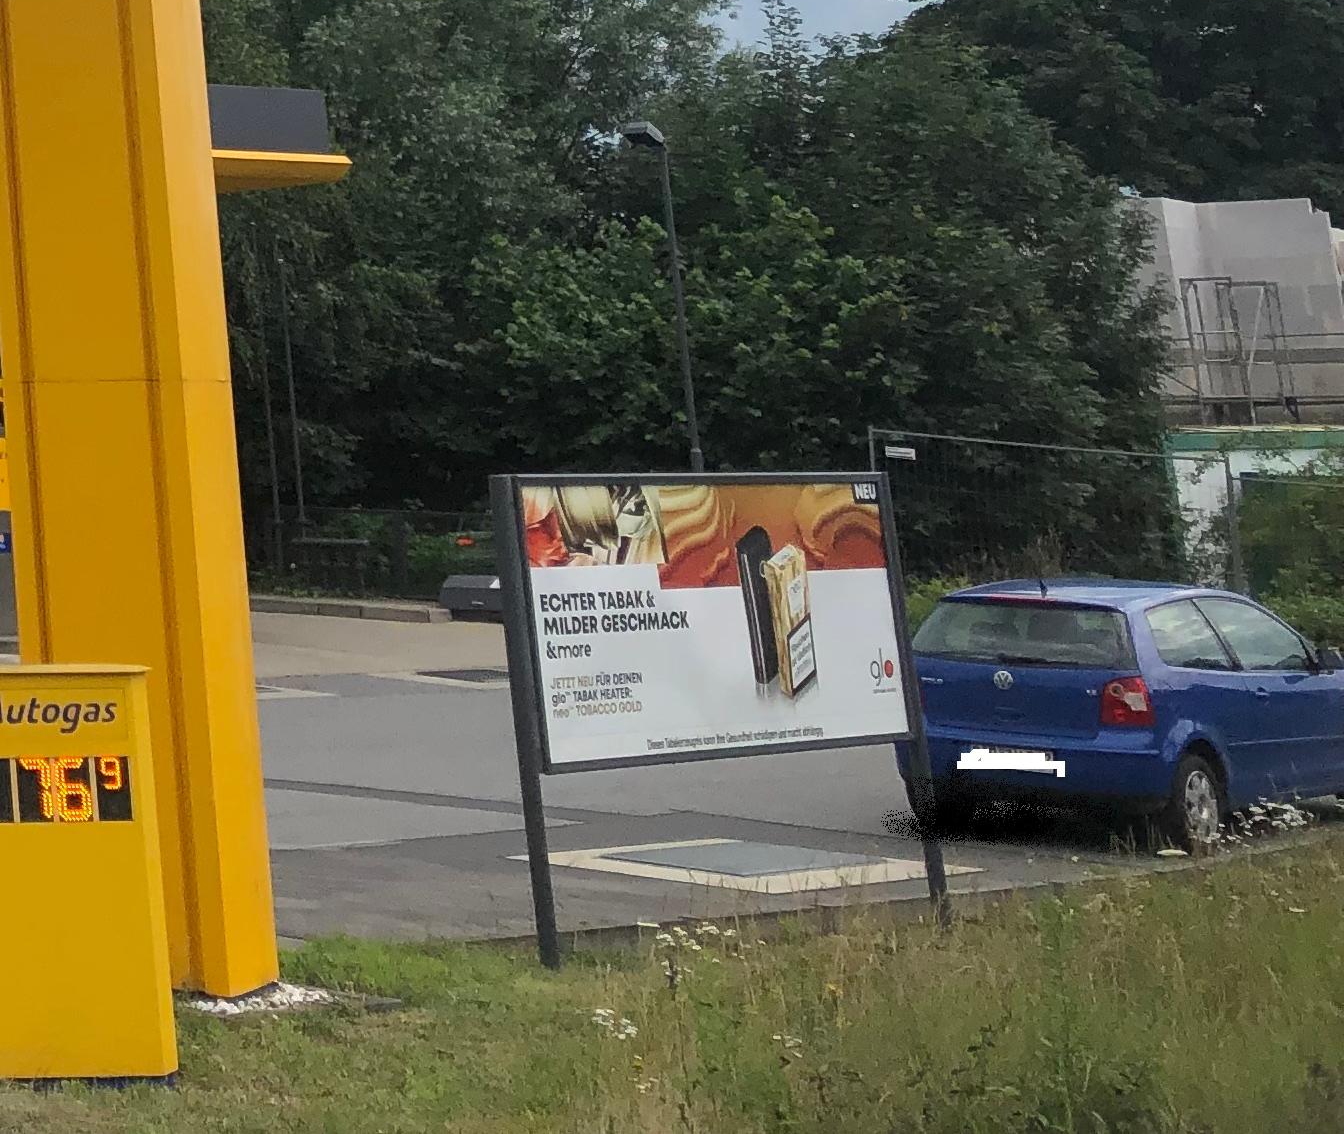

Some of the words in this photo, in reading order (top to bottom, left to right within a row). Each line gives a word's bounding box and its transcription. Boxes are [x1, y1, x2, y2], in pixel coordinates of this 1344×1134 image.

[854, 483, 876, 499] NEU
[540, 592, 597, 612] ECHTER
[598, 590, 644, 610] TABAK
[646, 590, 655, 608] &
[544, 615, 598, 635] MILDER
[601, 611, 689, 633] GESCHMACK
[870, 647, 894, 686] glo
[551, 677, 575, 689] JETZT
[595, 671, 611, 686] FÜR
[612, 672, 642, 685] DEINEN
[573, 690, 598, 702] TABAK
[575, 702, 617, 716] TOBACCO
[619, 701, 642, 713] GOLD
